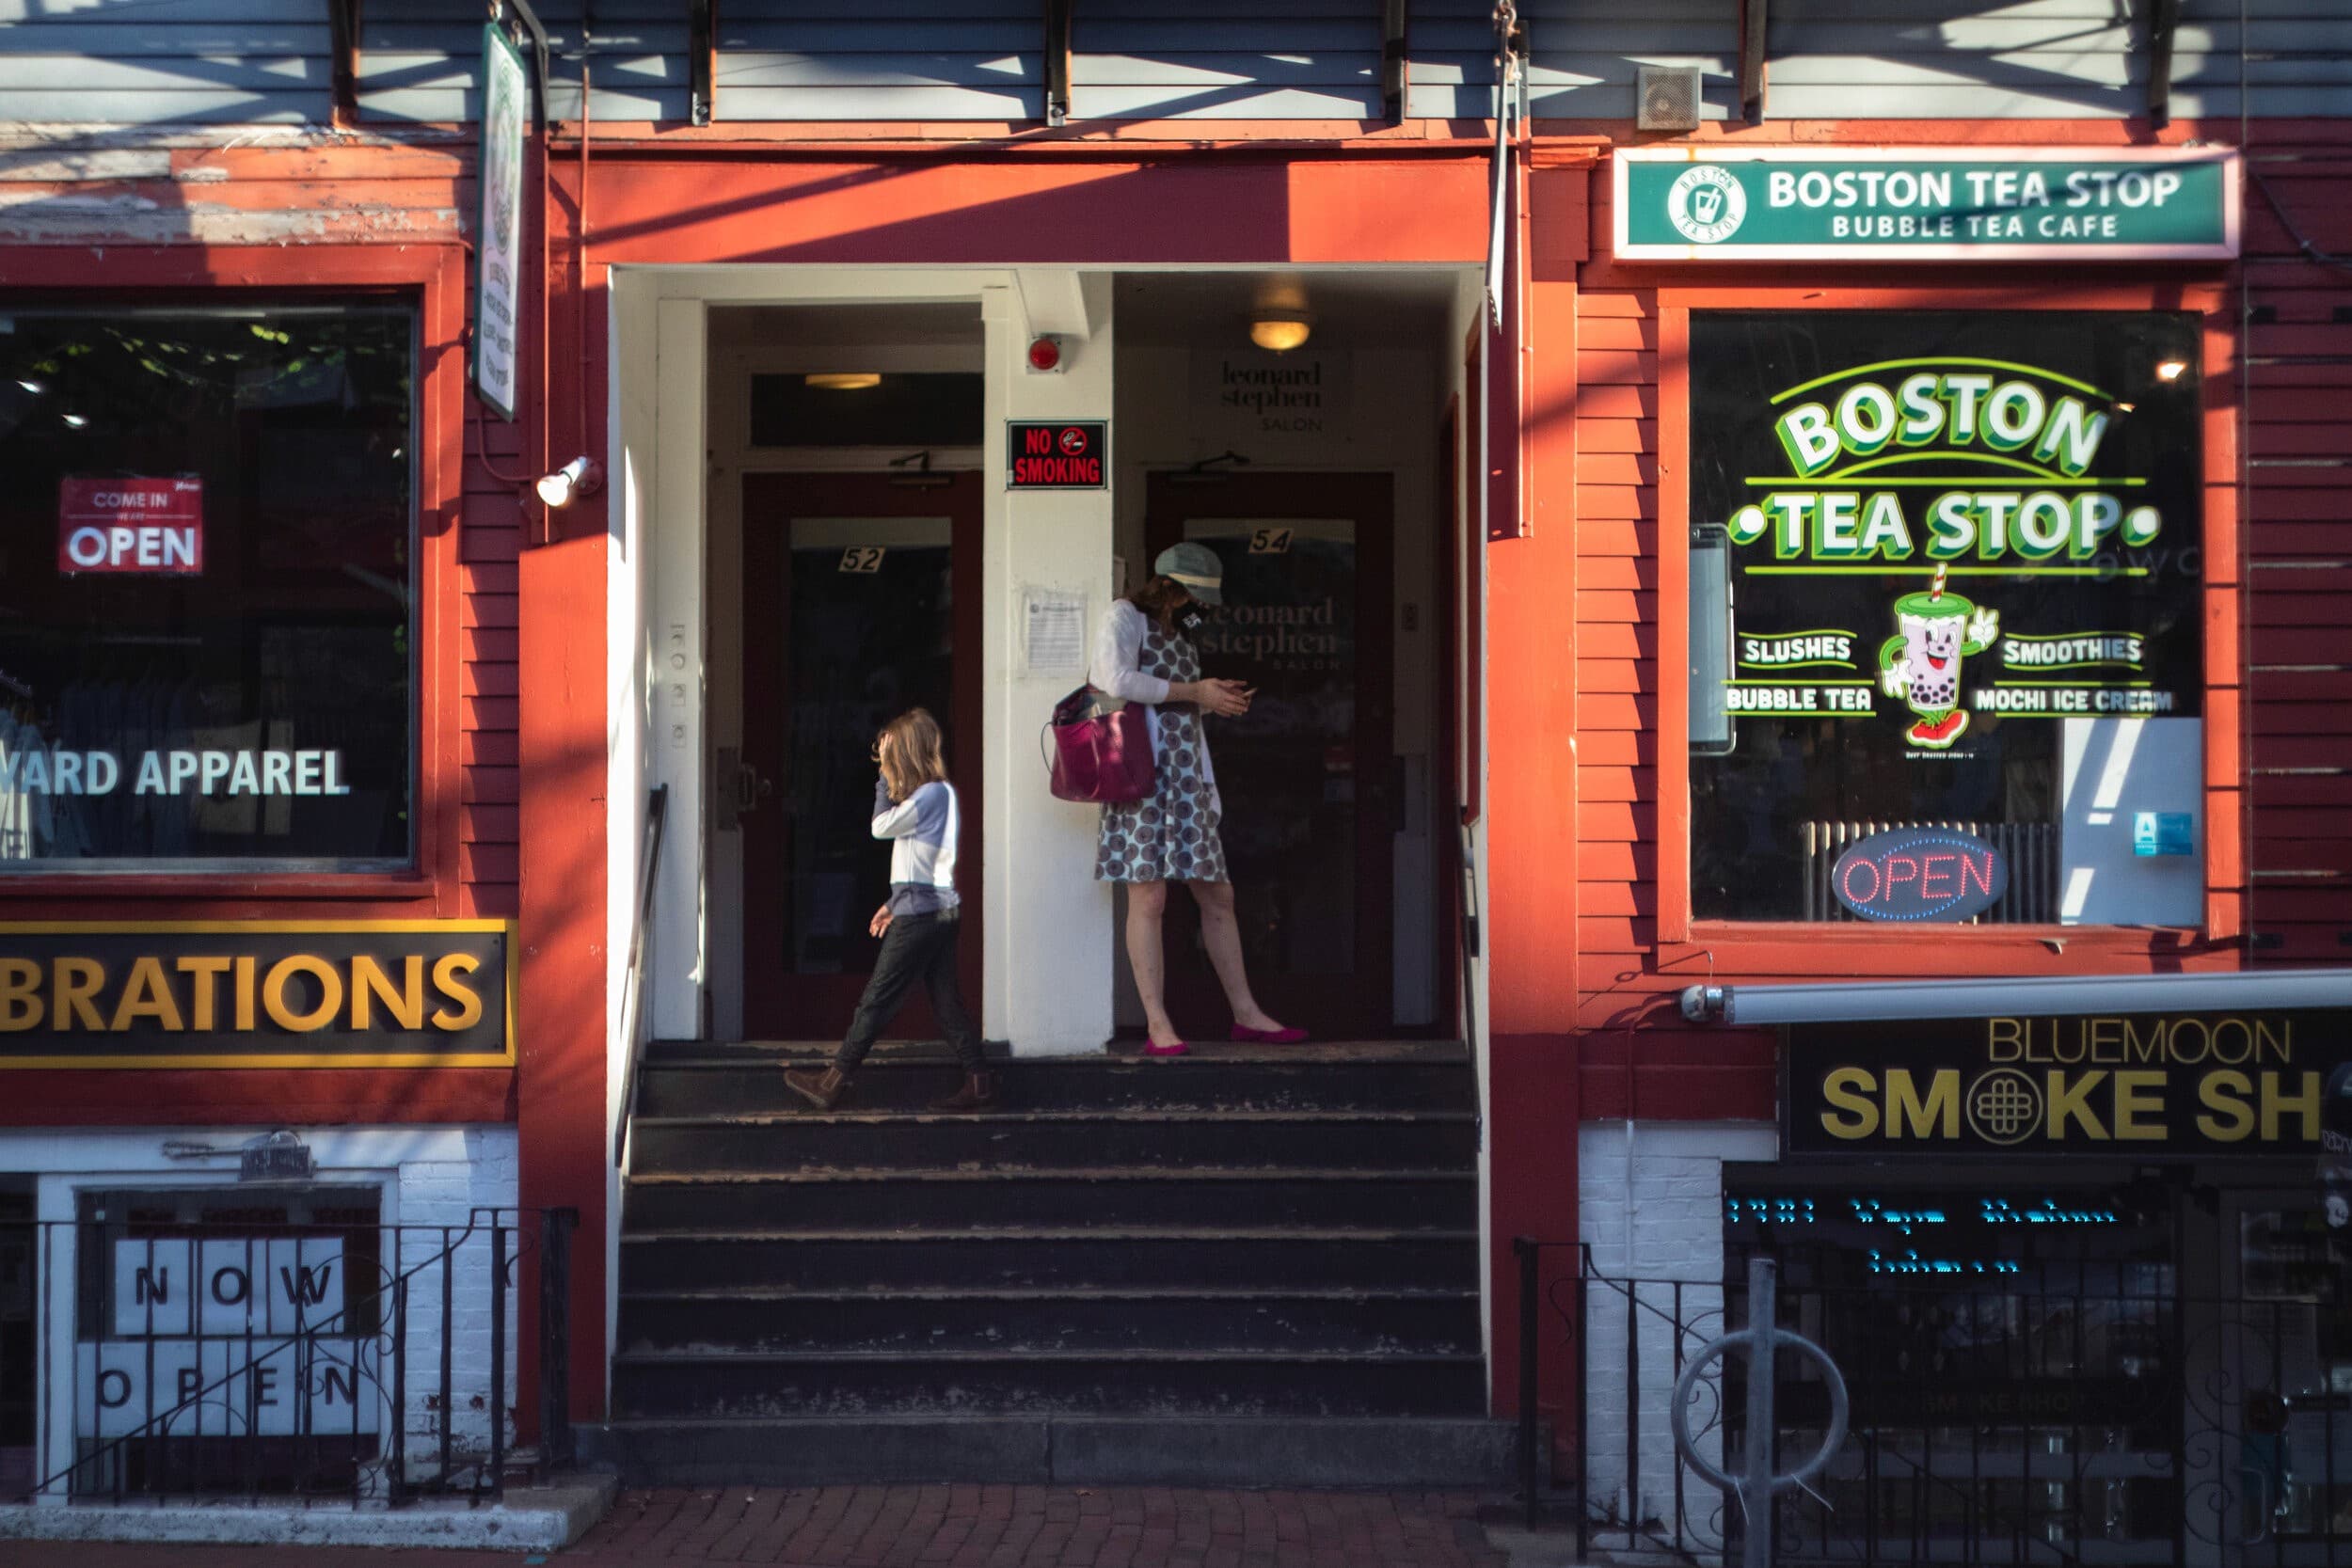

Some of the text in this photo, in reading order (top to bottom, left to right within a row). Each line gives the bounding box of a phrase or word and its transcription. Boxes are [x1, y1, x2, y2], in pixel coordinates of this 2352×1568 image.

[1678, 169, 1735, 190] BOSTON
[1769, 169, 2181, 208] BOSTON TEA STOP
[1708, 213, 1740, 240] STOP
[1833, 214, 2119, 239] BUBBLE TEA CAFE
[1222, 361, 1321, 384] leonard
[1221, 386, 1321, 414] stephen
[1262, 418, 1322, 432] SALON
[1775, 371, 2108, 479] BOSTON
[1025, 428, 1052, 455] NO
[1015, 457, 1100, 483] SMOKING
[93, 492, 167, 508] COME IN
[1252, 529, 1289, 550] 54
[1763, 490, 2122, 562] TEA STOP
[69, 526, 195, 566] OPEN
[842, 548, 880, 571] 52
[1206, 596, 1333, 625] eonard
[1201, 626, 1338, 661] stephen
[1744, 636, 1851, 662] SLUSHES
[2003, 638, 2142, 665] SMOOTHIES
[1273, 658, 1341, 671] SALON
[1726, 688, 1872, 711] BUBBLE TEA
[1976, 689, 2173, 711] MOCHI ICE CREAM
[0, 751, 350, 796] YARD APPAREL
[1843, 852, 1994, 905] OPEN
[0, 953, 483, 1033] BRATIONS
[1989, 1019, 2291, 1065] BLUEMOON
[135, 1266, 332, 1307] NOW
[97, 1367, 355, 1409] OPEN
